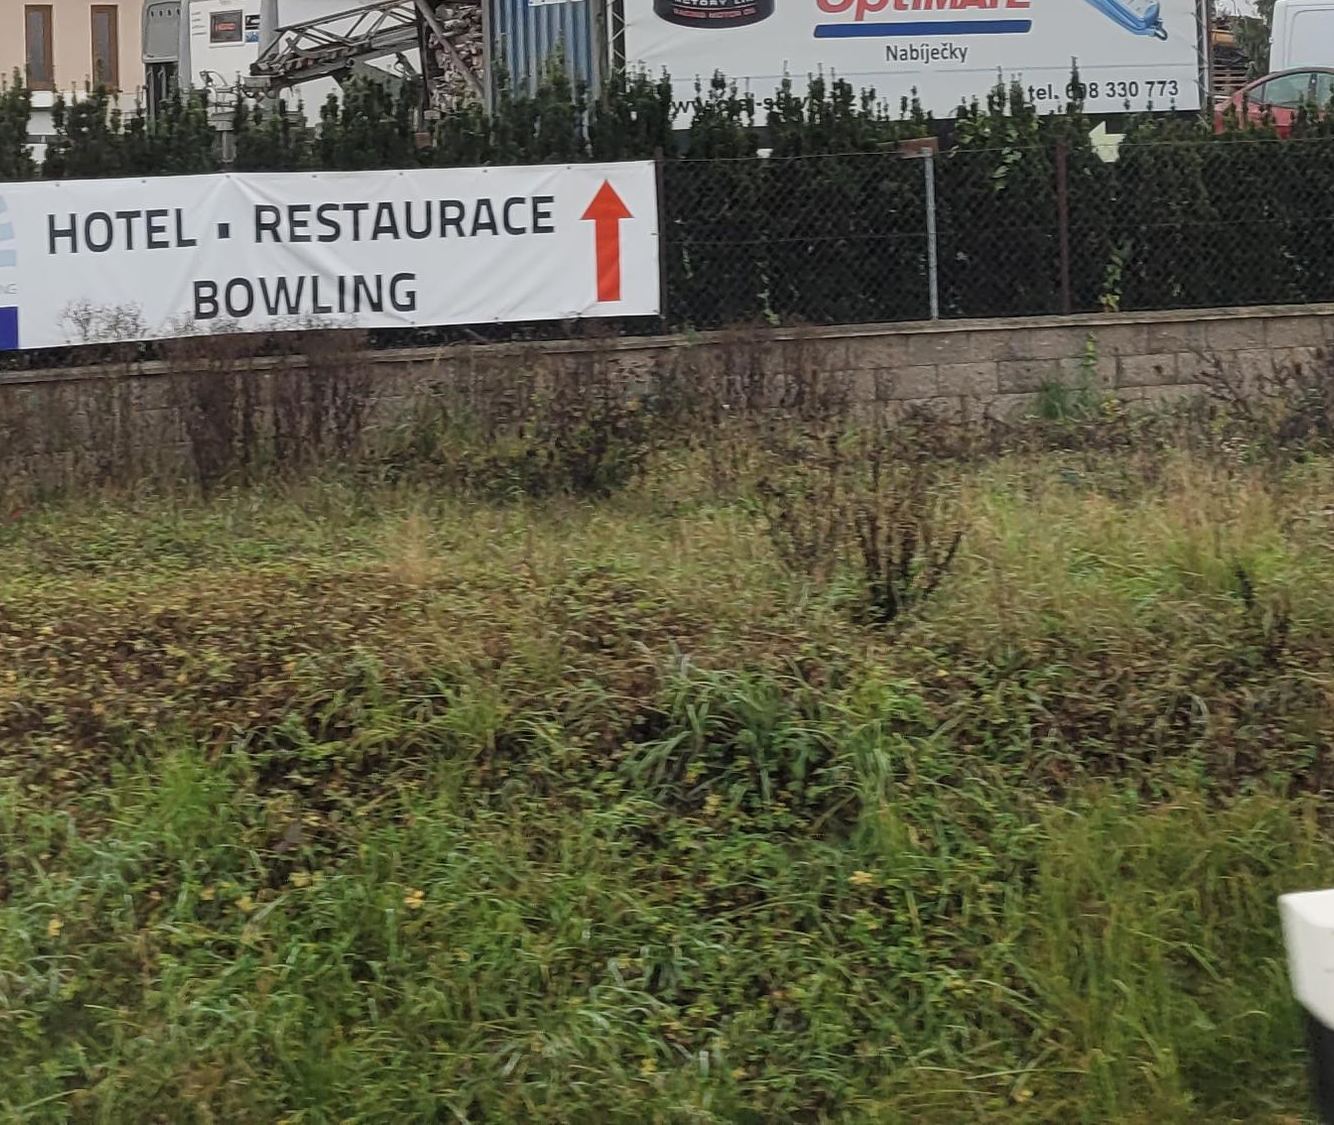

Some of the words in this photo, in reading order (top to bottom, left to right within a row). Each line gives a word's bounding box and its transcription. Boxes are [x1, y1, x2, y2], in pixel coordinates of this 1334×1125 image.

[885, 42, 969, 63] Nabíječky
[1027, 82, 1060, 101] tel.
[1105, 81, 1139, 98] 330
[1144, 80, 1179, 97] 773
[48, 208, 197, 255] HOTEL
[254, 195, 556, 244] RESTAURACE
[193, 272, 417, 320] BOWLING
